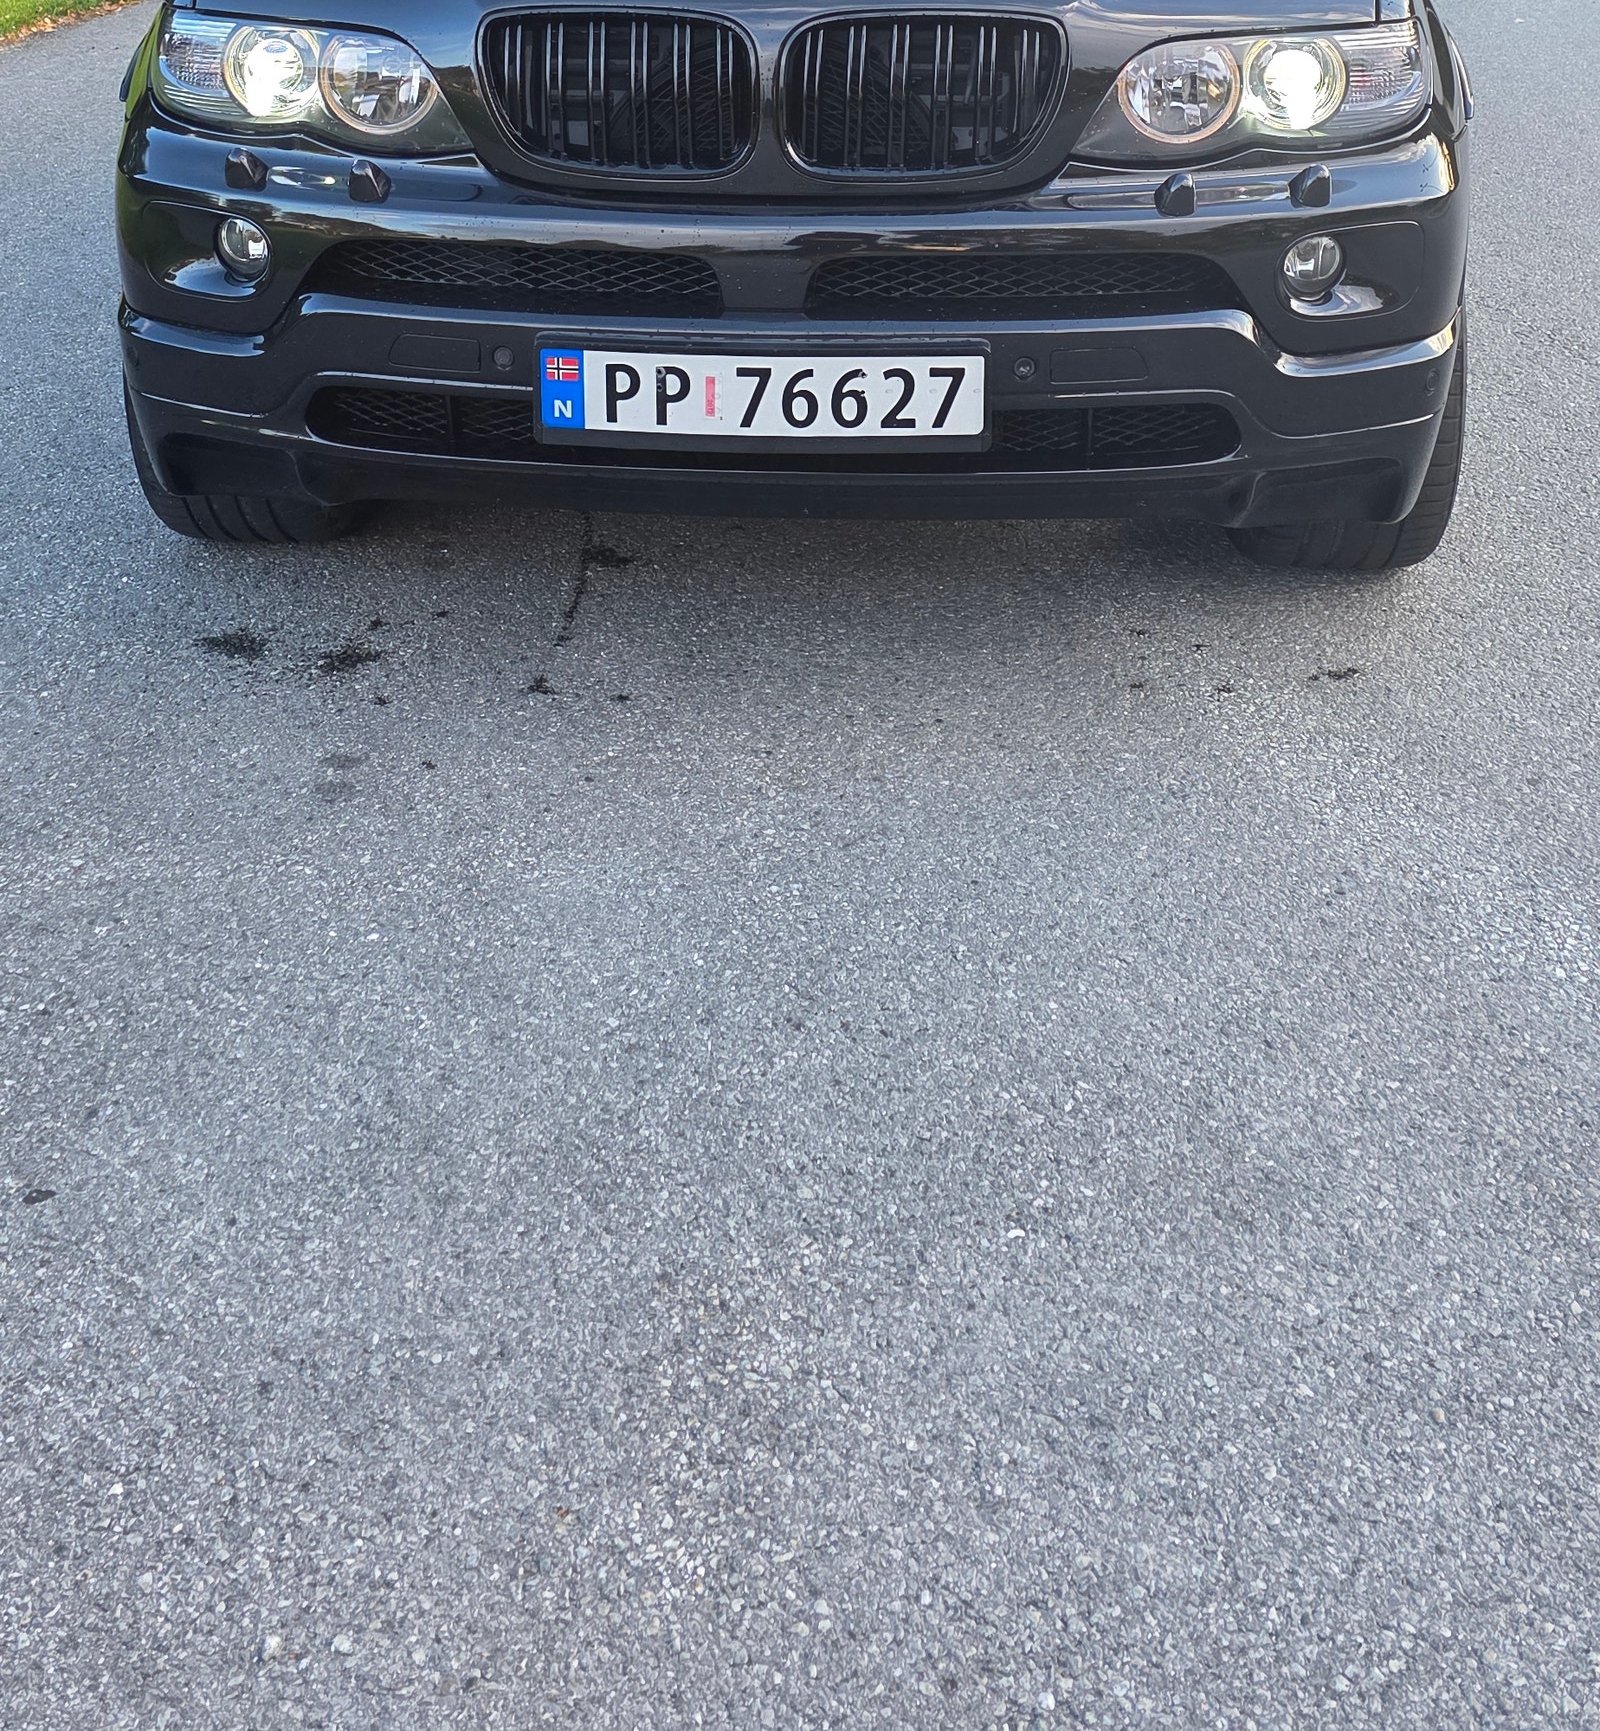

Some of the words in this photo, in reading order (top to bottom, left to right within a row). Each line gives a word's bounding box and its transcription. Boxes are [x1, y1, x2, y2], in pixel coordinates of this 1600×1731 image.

[553, 399, 573, 419] N
[605, 364, 691, 426] PP
[735, 367, 966, 429] 76627
